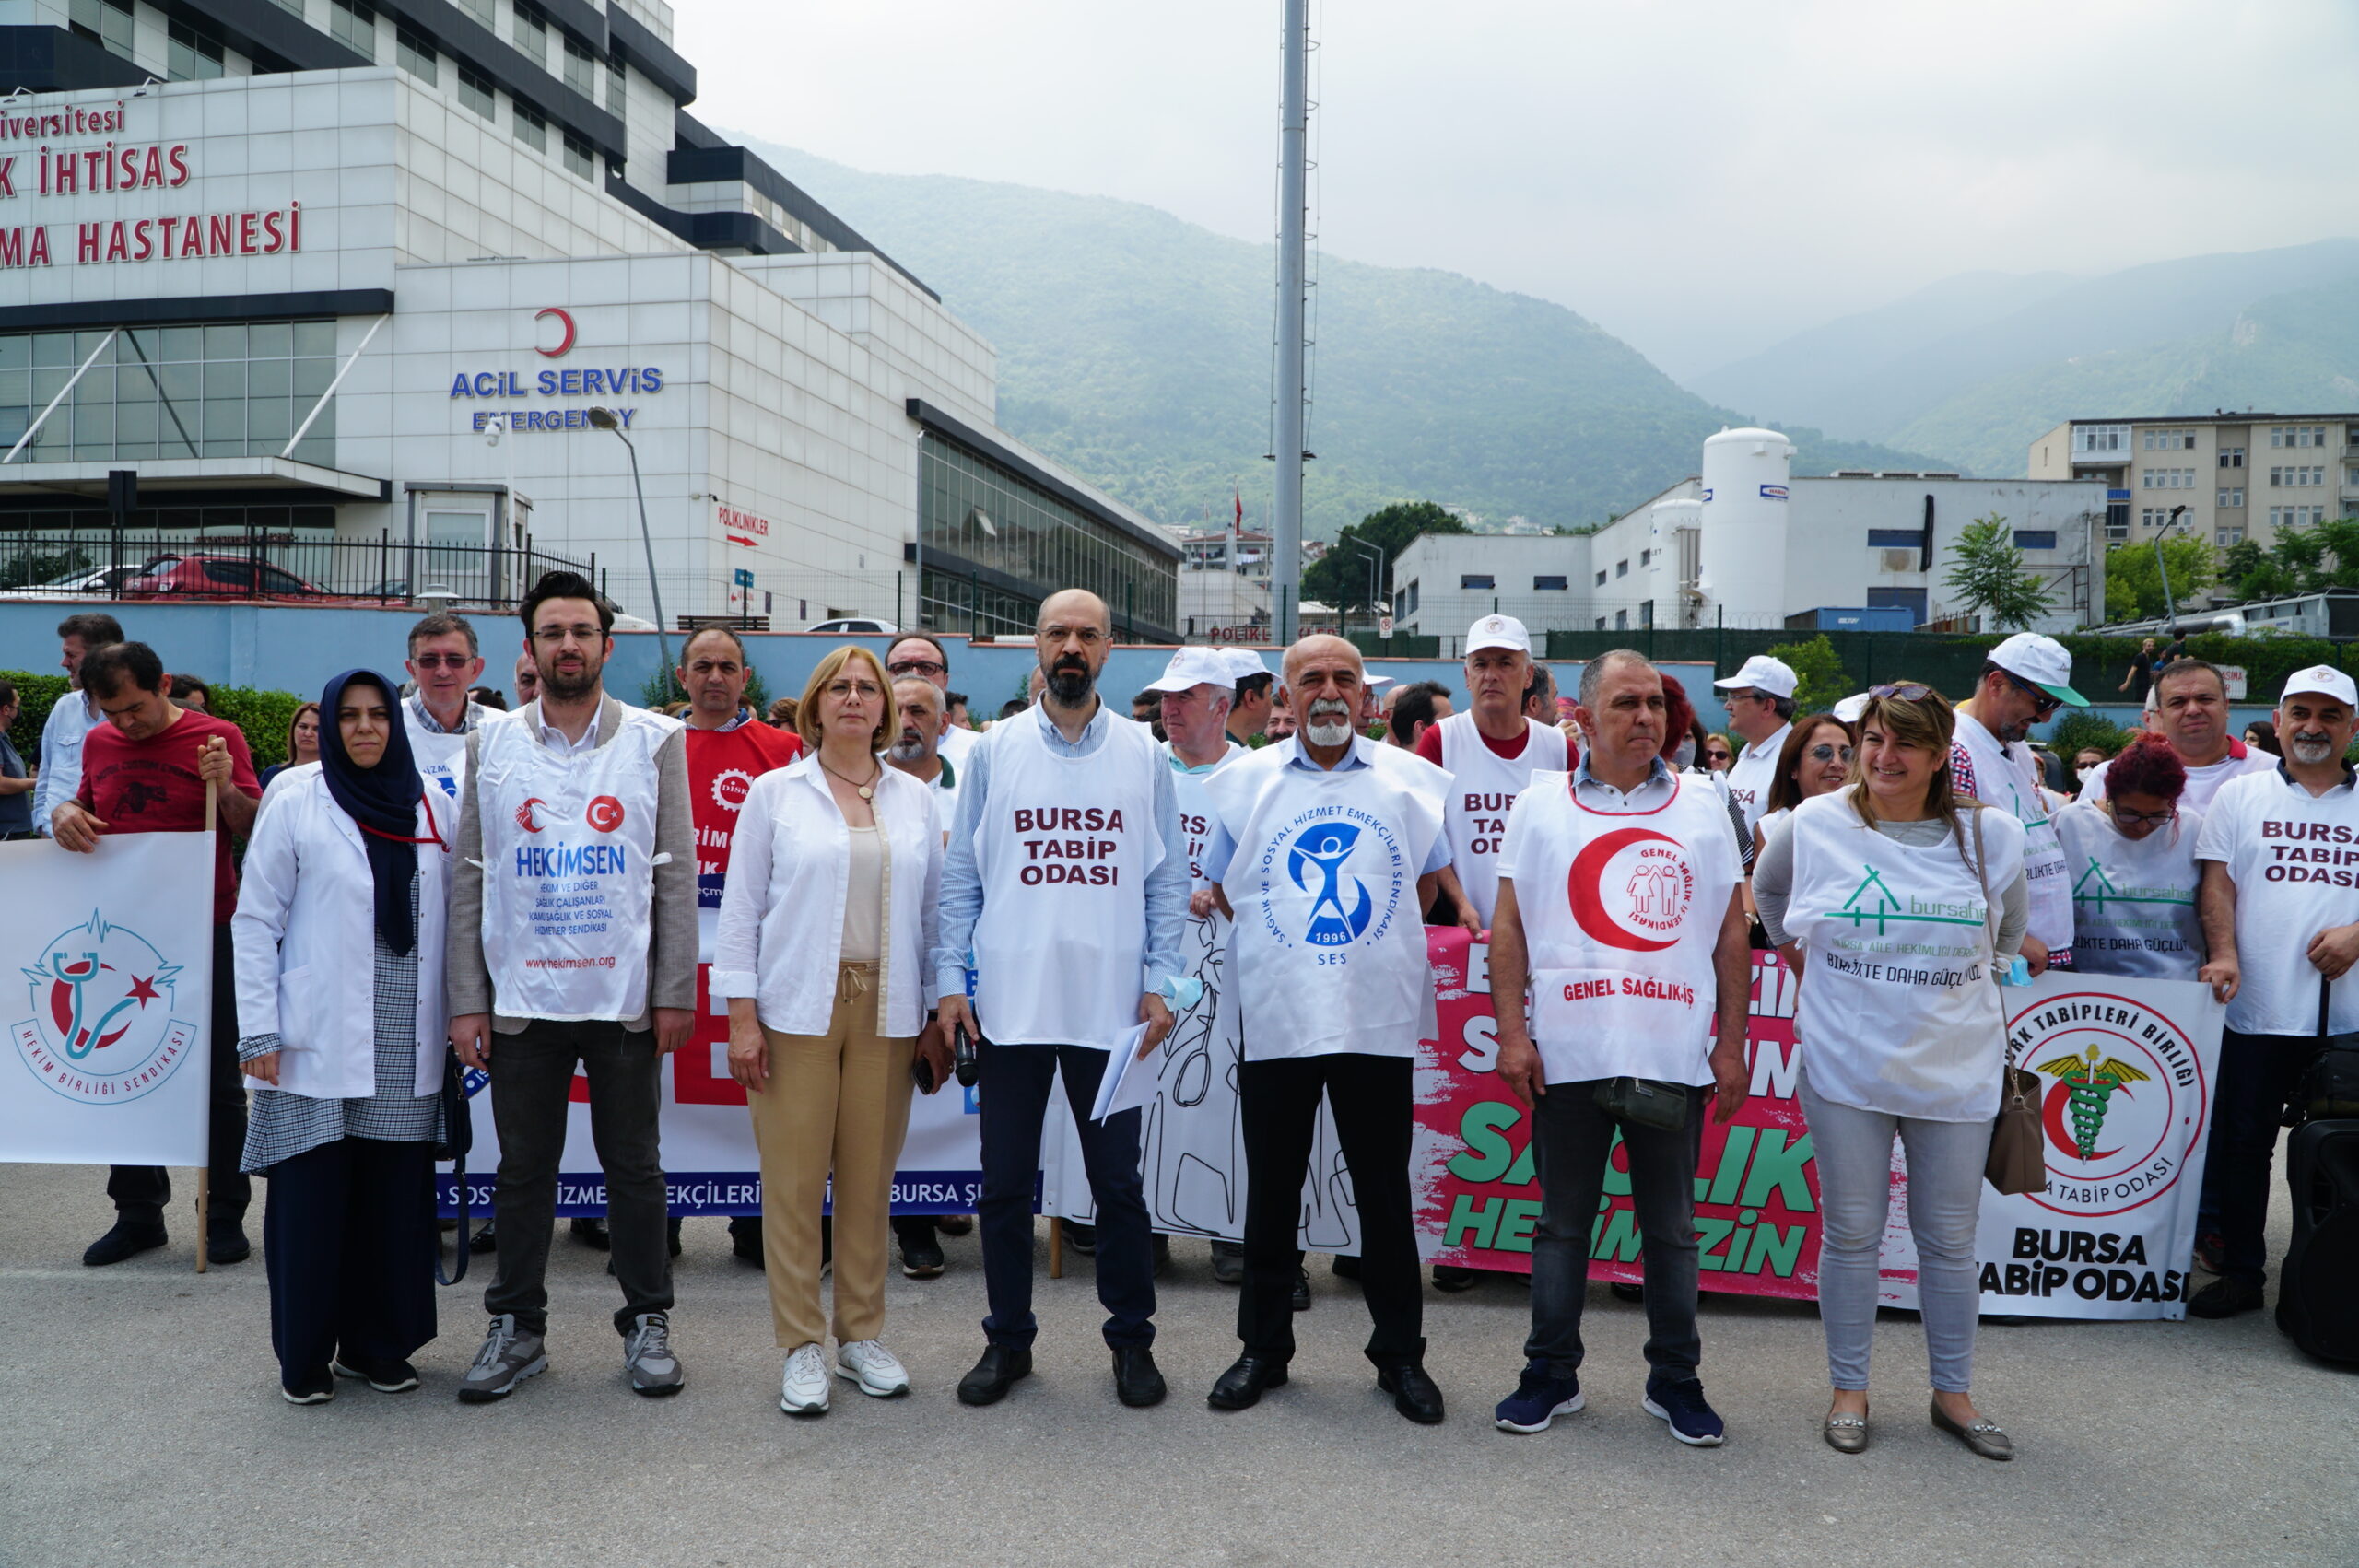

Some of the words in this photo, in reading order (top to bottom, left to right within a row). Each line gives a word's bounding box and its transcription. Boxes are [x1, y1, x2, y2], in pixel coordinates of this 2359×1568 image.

[39, 140, 190, 196] İHTİSAS
[77, 200, 301, 264] HASTANESİ
[473, 408, 637, 432] EERGENY
[722, 780, 749, 796] DİSK
[1014, 807, 1124, 833] BURSA
[1293, 805, 1344, 827] HİZMET
[1473, 818, 1507, 834] TA
[1023, 836, 1117, 860] TABİP
[1347, 807, 1405, 867] EMEKÇİLERİ
[516, 841, 625, 877] HEKİMSEN
[1261, 825, 1293, 874] SOSYAL
[1640, 848, 1677, 862] GENEL
[561, 883, 571, 893] VE
[573, 879, 598, 892] DİĞER
[1019, 863, 1118, 886] ODASI
[1678, 860, 1695, 902] SAĞLIK
[1261, 880, 1270, 895] VE
[573, 910, 584, 920] VE
[586, 908, 614, 919] SOSYAL
[1262, 899, 1286, 943] SAĞLIK
[1628, 911, 1683, 931] SENDİKASI
[1315, 931, 1347, 943] 1996
[2110, 938, 2143, 951] DAHA
[1318, 953, 1347, 965] SES
[1886, 966, 1928, 986] DAHA
[1563, 978, 1615, 1001] GENEL
[2033, 1002, 2139, 1031] TABİPLERİ
[2142, 1023, 2195, 1087] BİRLİĞİ
[22, 1029, 54, 1073] HEKİM
[58, 1073, 115, 1095] BİRLİĞİ
[124, 1030, 186, 1092] SENDİKASI
[2059, 1184, 2110, 1203] TABİP
[2114, 1156, 2173, 1199] ODASI
[890, 1184, 959, 1203] BURSA
[2013, 1227, 2147, 1266] BURSA
[1976, 1259, 2069, 1297] ABİP
[2072, 1268, 2190, 1303] ODASI
